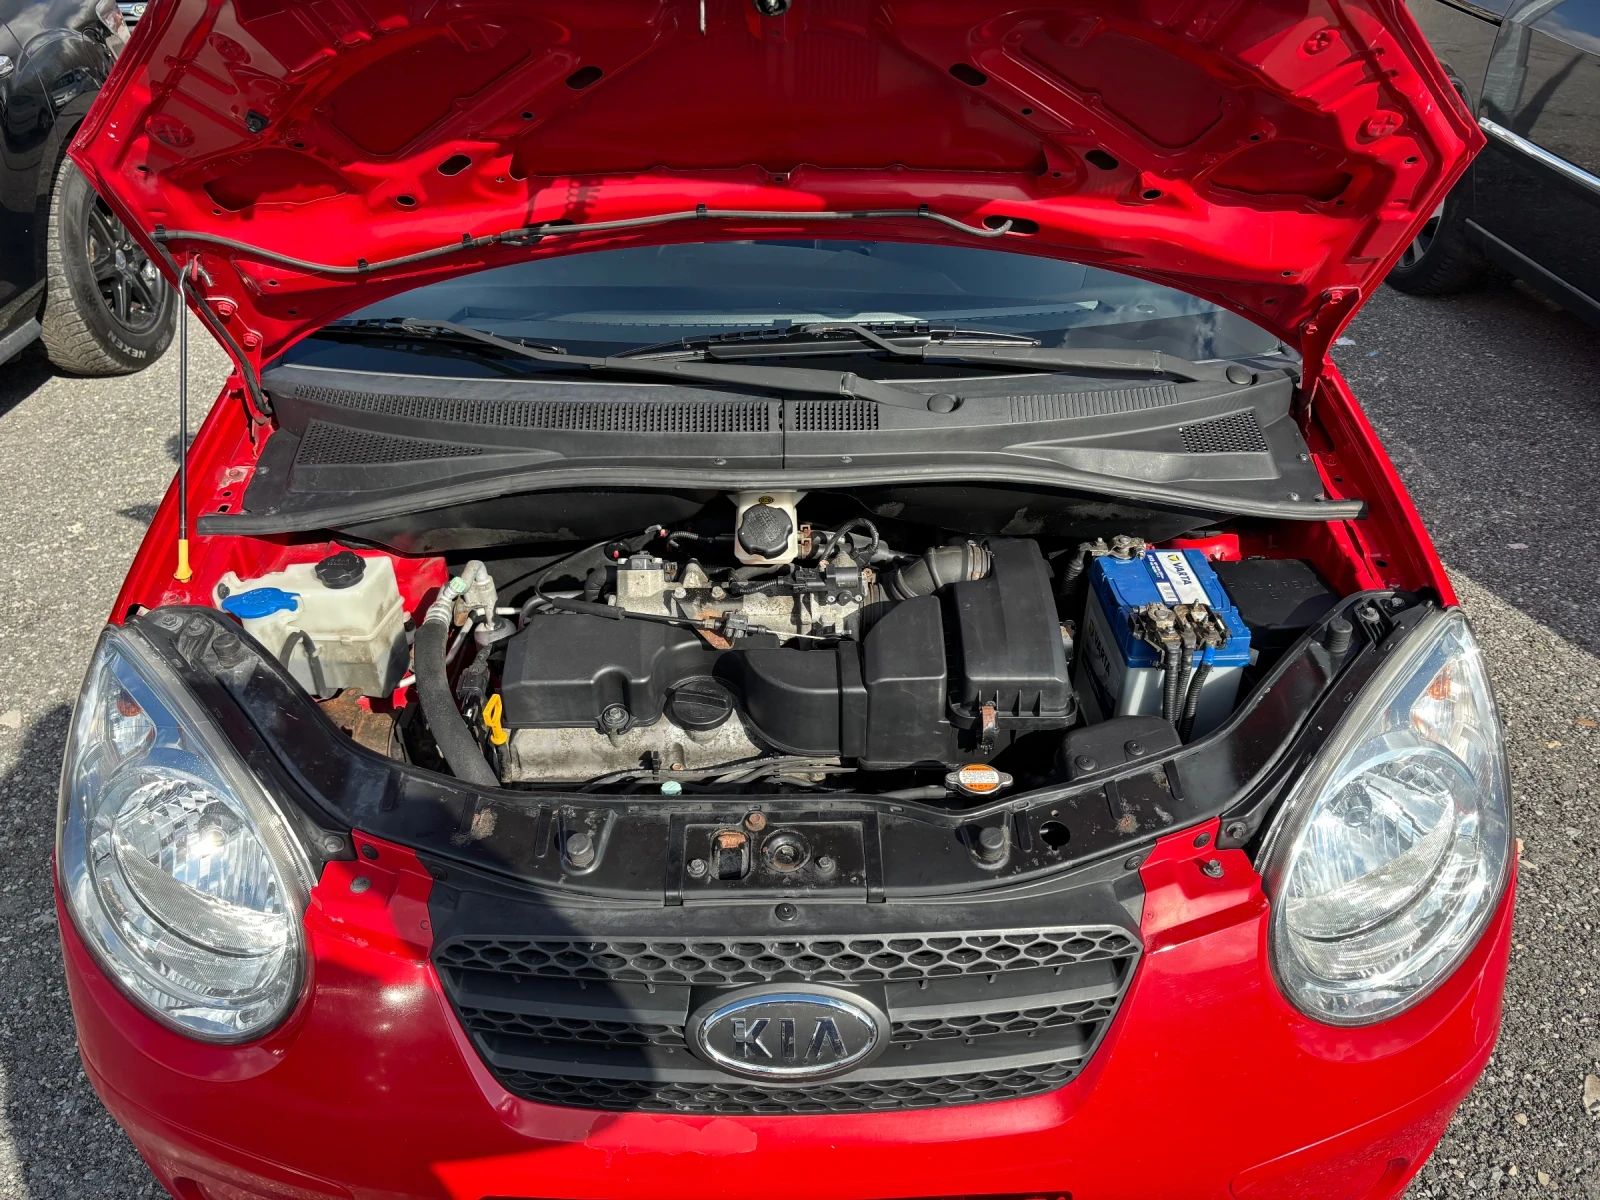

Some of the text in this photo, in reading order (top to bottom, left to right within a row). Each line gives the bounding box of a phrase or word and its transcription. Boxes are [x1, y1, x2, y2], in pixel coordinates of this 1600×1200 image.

[107, 330, 147, 359] NEXEN
[1172, 562, 1192, 586] VARTA
[1094, 629, 1111, 678] VARTA
[730, 1016, 849, 1064] KIA
